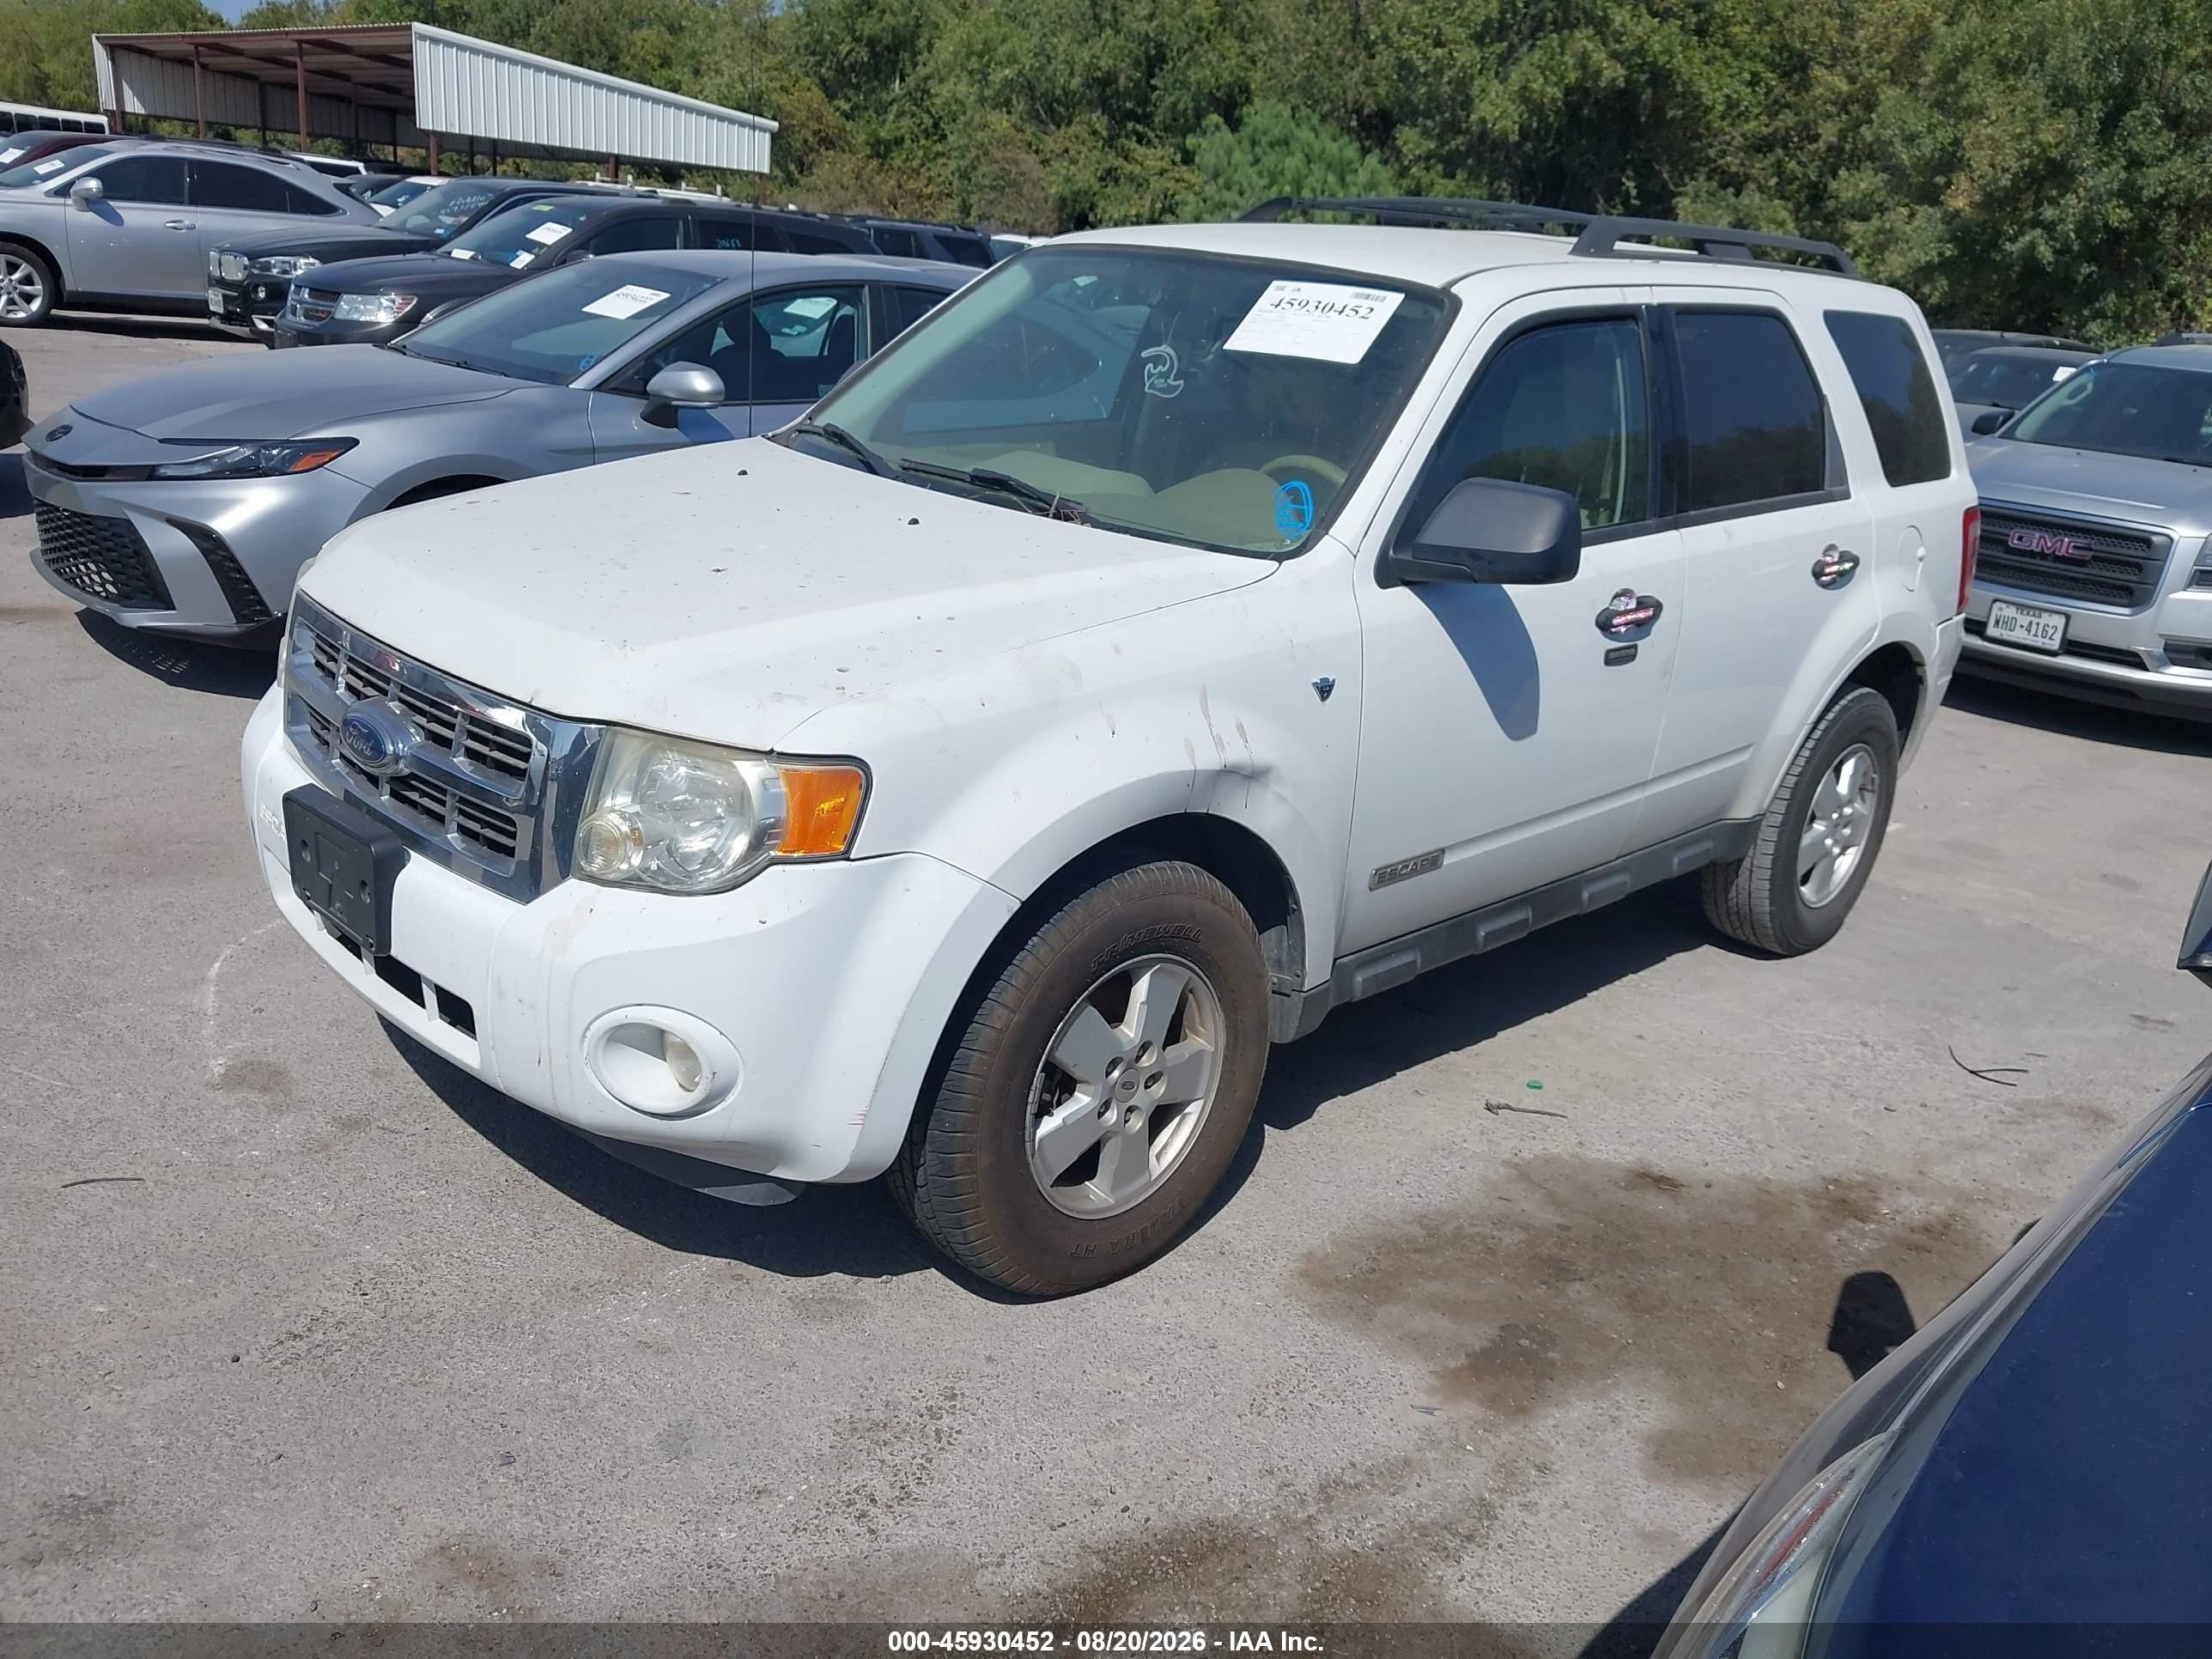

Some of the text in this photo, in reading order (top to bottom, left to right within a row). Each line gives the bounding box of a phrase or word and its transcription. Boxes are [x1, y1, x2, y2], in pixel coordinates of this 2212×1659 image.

[1271, 297, 1375, 319] 45930452
[2008, 529, 2091, 560] GMC
[2015, 607, 2043, 619] TEXAS
[345, 721, 373, 756] Ford
[1375, 851, 1442, 886] ESCAPE
[1068, 1242, 1097, 1258] HT
